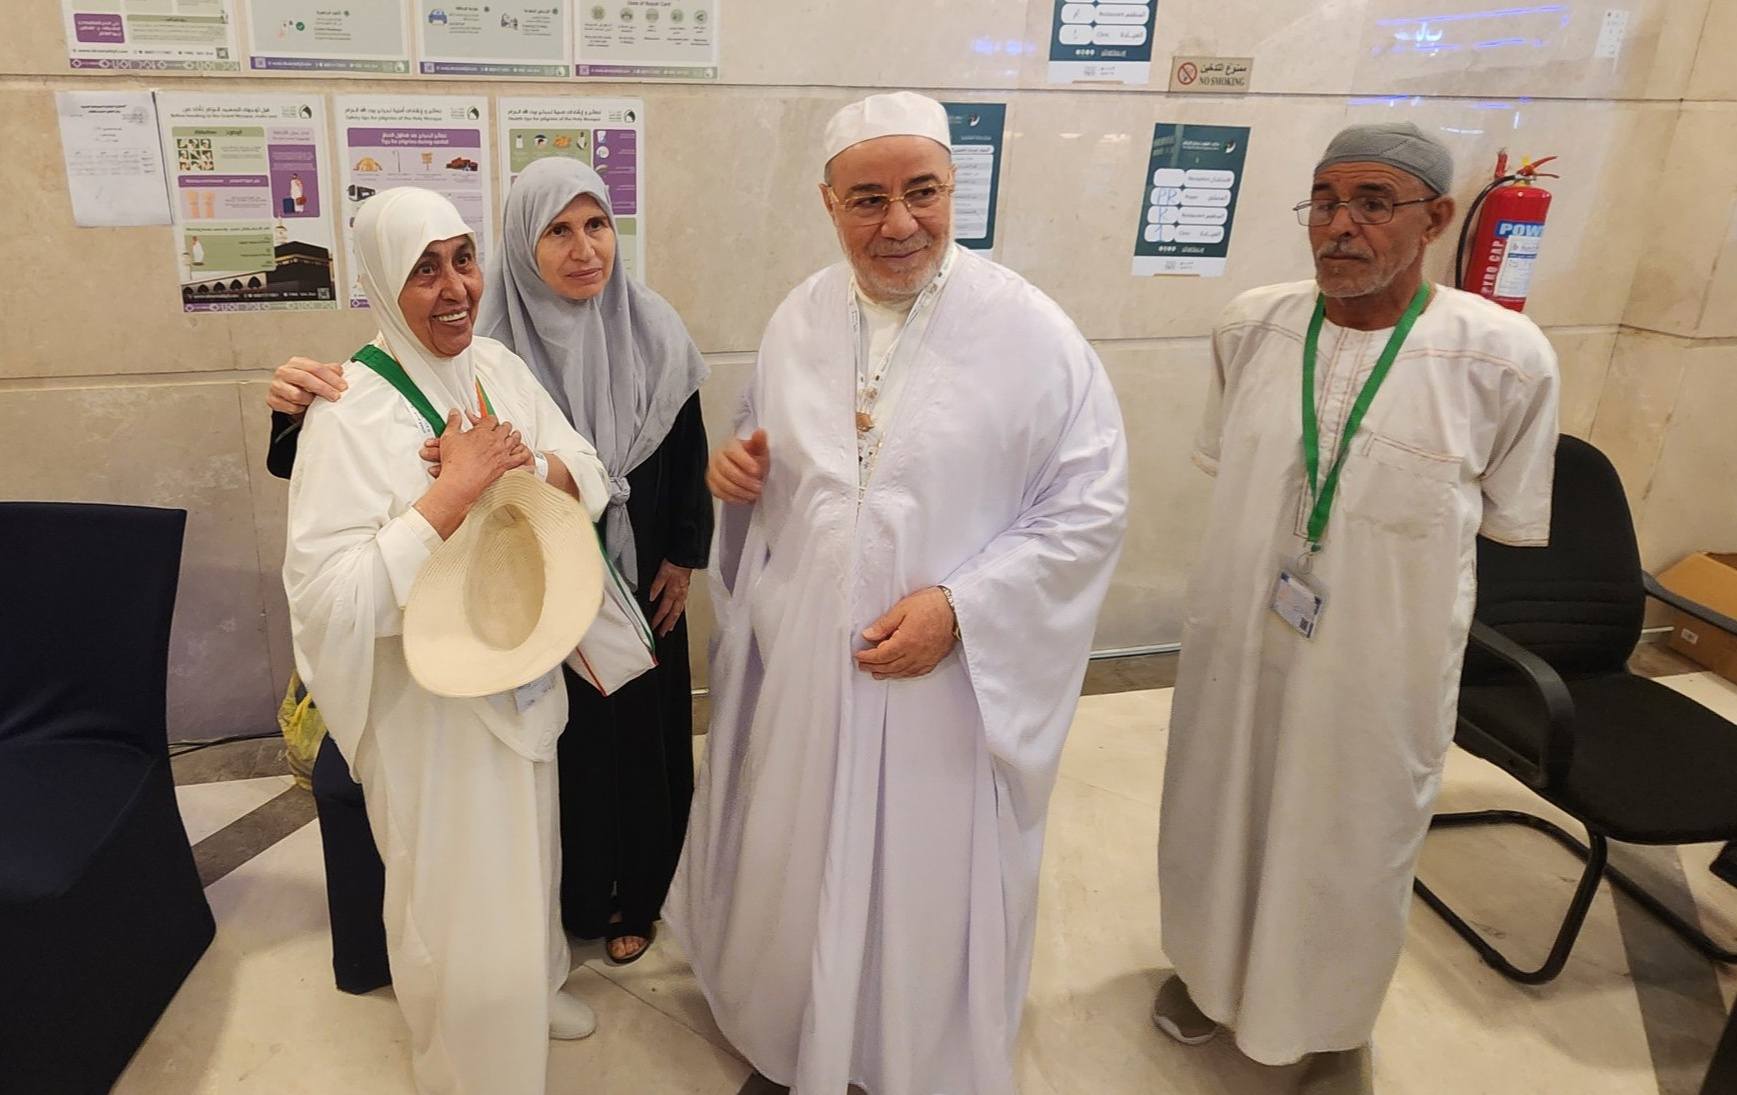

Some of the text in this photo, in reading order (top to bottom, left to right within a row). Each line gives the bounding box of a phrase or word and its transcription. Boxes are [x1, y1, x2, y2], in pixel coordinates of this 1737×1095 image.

[1226, 63, 1247, 76] ممنوع
[1200, 77, 1245, 86] NO SMOKING
